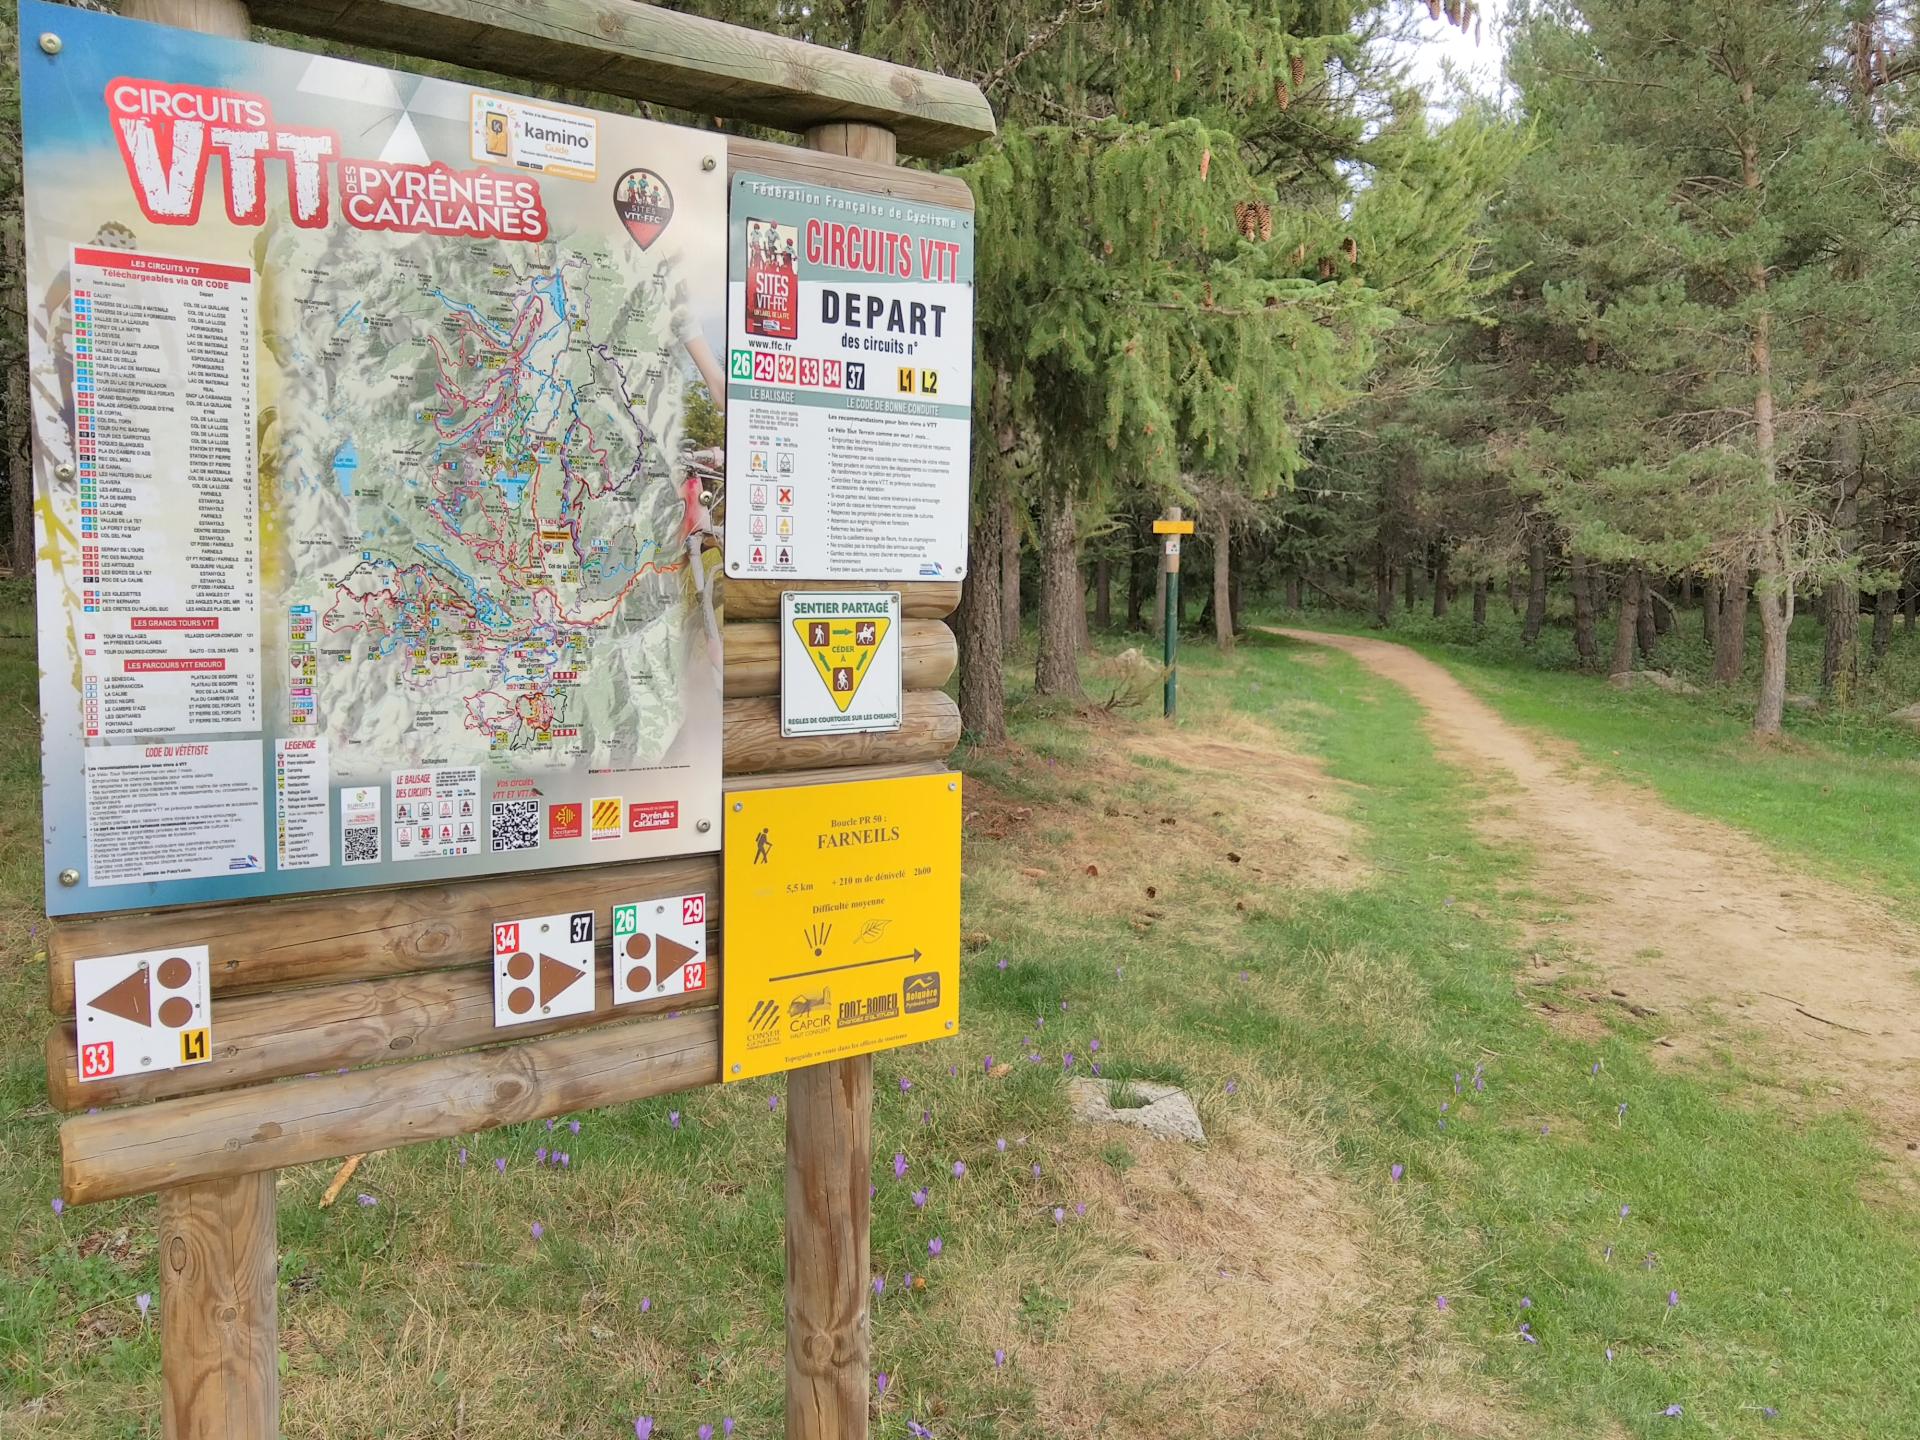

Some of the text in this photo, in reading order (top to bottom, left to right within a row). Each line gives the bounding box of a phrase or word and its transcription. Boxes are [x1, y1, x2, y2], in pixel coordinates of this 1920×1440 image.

[114, 86, 266, 126] CIRCUITS
[525, 122, 589, 148] kamino
[119, 117, 332, 220] VTT
[345, 166, 358, 193] DES
[360, 167, 534, 209] PYRÉNÉES
[349, 195, 542, 236] CATALANES
[632, 205, 655, 214] SITES
[753, 182, 956, 229] Fédération Française de Cyclisme
[806, 219, 961, 284] CIRCUITS VTT
[131, 259, 200, 274] LES CIRCUITS VTT
[102, 269, 229, 290] Téléchargeables via QR CODE
[756, 272, 789, 297] SITES
[757, 294, 787, 311] VTT-FFC
[822, 289, 946, 337] DEPART
[749, 340, 792, 351] www.ffc.fr
[841, 333, 918, 355] des circuits n°
[734, 352, 938, 393] 26 29 32 33 34 37 L1 L2
[751, 389, 794, 402] LE BALISAGE
[847, 398, 939, 416] LE CODE DE BONNE CONDUITE
[838, 416, 884, 424] recommandations
[794, 600, 888, 613] SENTIER PARTAGÉ
[143, 661, 179, 669] PARCOURS
[195, 660, 222, 668] ENDURO
[145, 744, 208, 758] CODE DU VÉTÉTISTE
[285, 740, 316, 750] LEGENDE
[397, 774, 431, 784] LE BALISAGE
[396, 788, 432, 798] DES CIRCUITS
[493, 791, 504, 799] VTT
[831, 818, 857, 828] Boucle
[859, 816, 871, 825] PR
[873, 815, 882, 823] 50
[817, 826, 900, 849] FARNEILS
[786, 884, 799, 894] 5,5
[800, 883, 814, 892] km
[839, 877, 853, 886] 210
[864, 874, 874, 882] de
[875, 870, 906, 881] dénivelé
[914, 867, 931, 876] 2h00
[615, 899, 703, 933] 26 29
[812, 898, 885, 914] Difficulté moyenne
[496, 916, 591, 952] 34 37
[685, 965, 702, 988] 32
[906, 988, 937, 1000] Bolquère
[839, 993, 898, 1019] FONT-ROMEU
[790, 1014, 831, 1032] CAPCIR
[747, 1030, 779, 1041] CONSEIL
[86, 1031, 204, 1075] 33 L1
